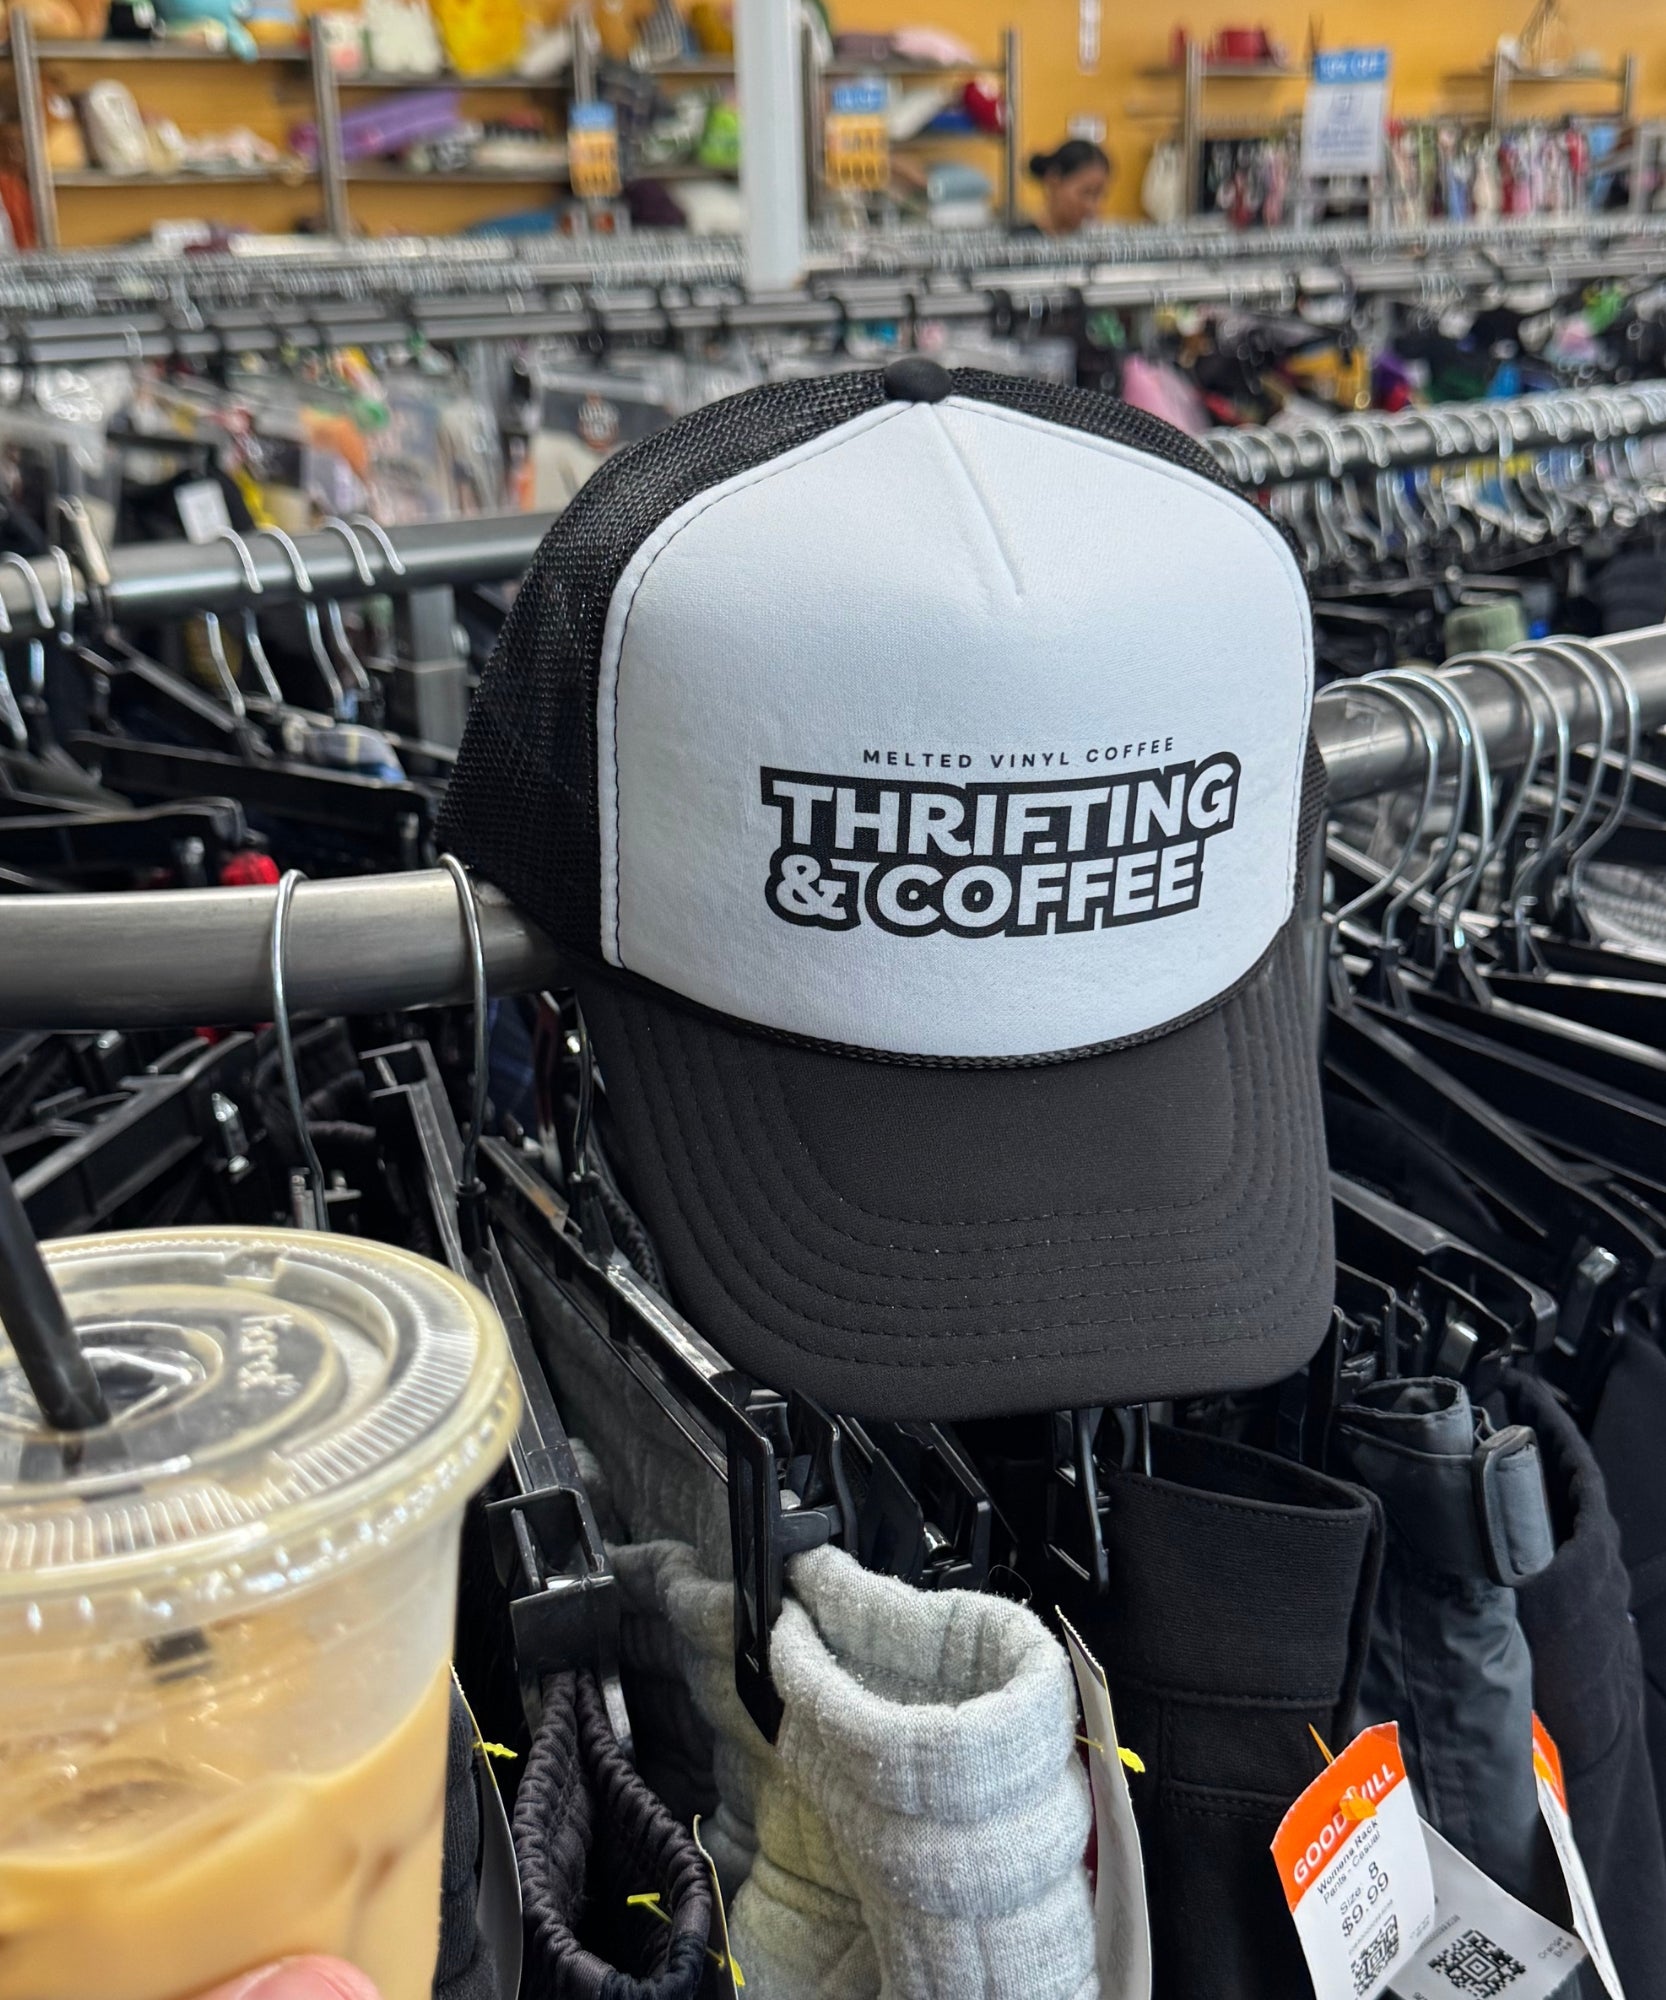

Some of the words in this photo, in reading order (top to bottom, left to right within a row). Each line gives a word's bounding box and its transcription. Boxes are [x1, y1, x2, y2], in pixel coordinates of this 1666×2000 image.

[863, 749, 973, 768] MELTED
[990, 752, 1070, 768] VINYL
[1086, 736, 1175, 762] COFFEE
[766, 757, 1238, 857] THRIFTING
[775, 854, 848, 921] &
[876, 844, 1200, 927] COFFEE
[1293, 1763, 1396, 1884] GOODILL
[1354, 1819, 1378, 1847] Rack
[1368, 1861, 1379, 1880] 8
[1341, 1871, 1390, 1937] $9.99
